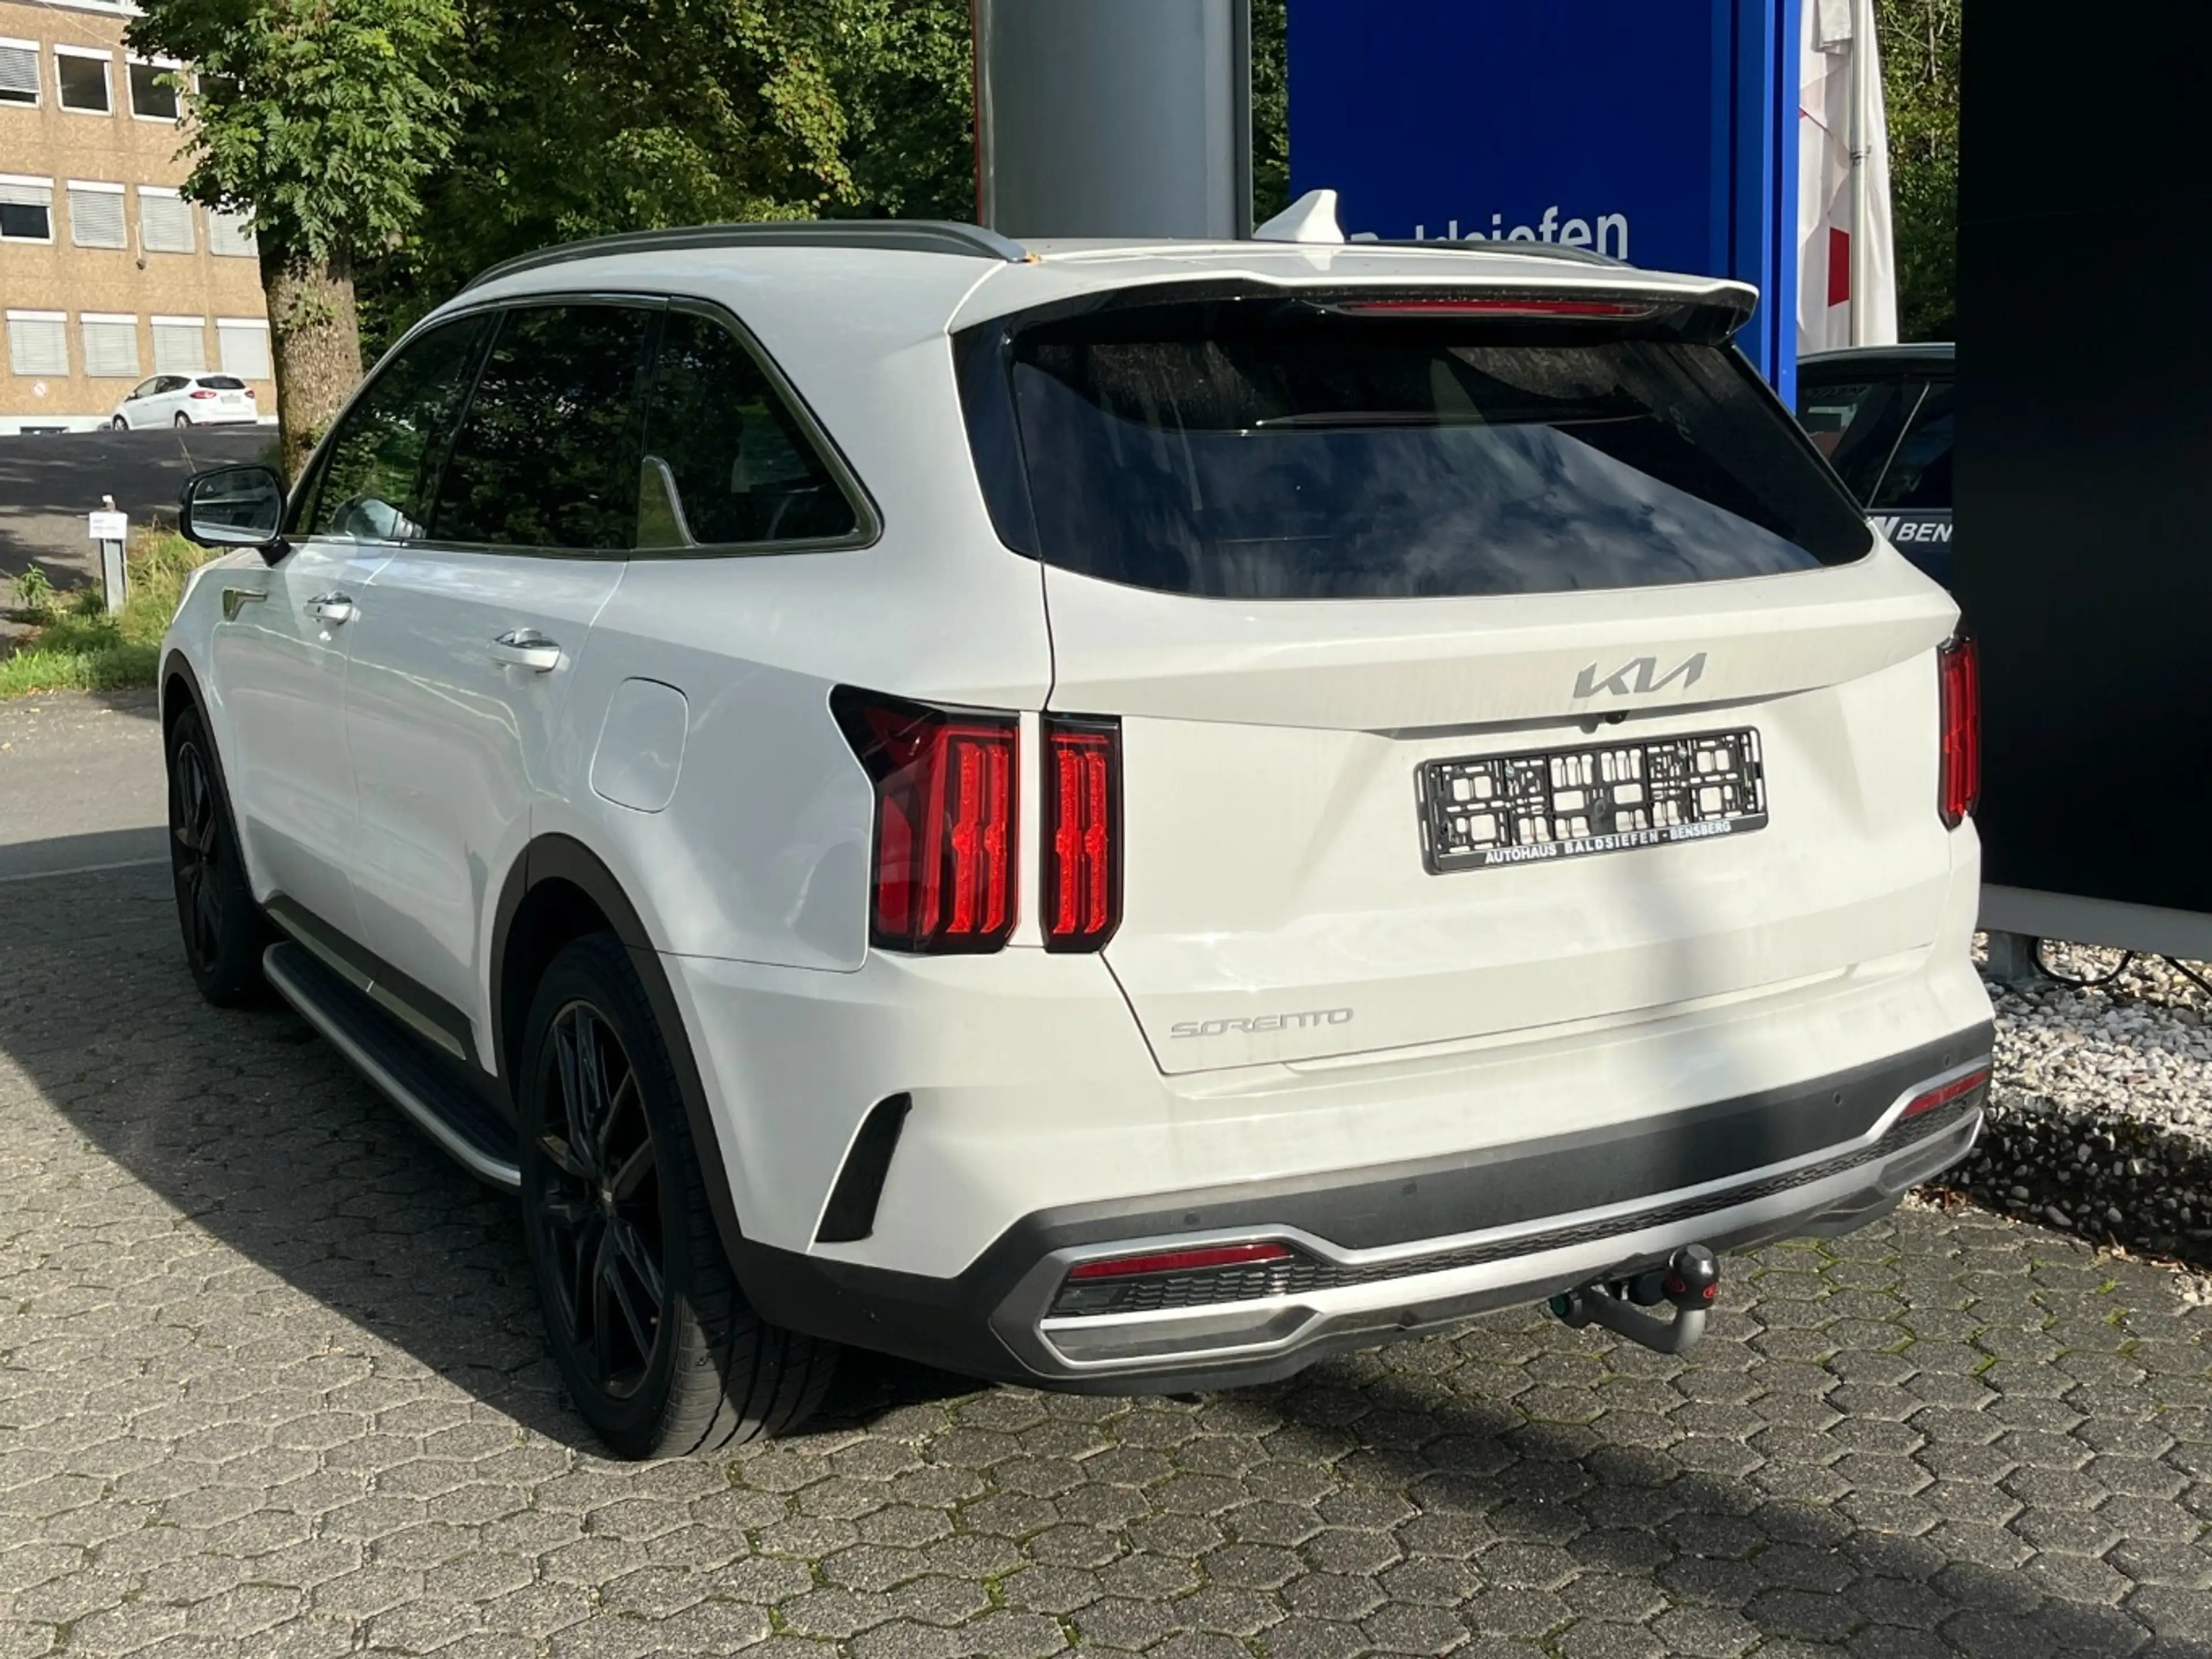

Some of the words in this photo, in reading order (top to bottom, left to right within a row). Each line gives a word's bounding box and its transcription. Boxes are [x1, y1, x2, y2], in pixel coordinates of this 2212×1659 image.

[1573, 652, 1707, 698] KIA
[1485, 844, 1557, 864] AUTOHAUS
[1564, 830, 1659, 854] BALDSIEFEN
[1670, 821, 1731, 840] BENSBERG
[1171, 1007, 1355, 1039] SORENTO
